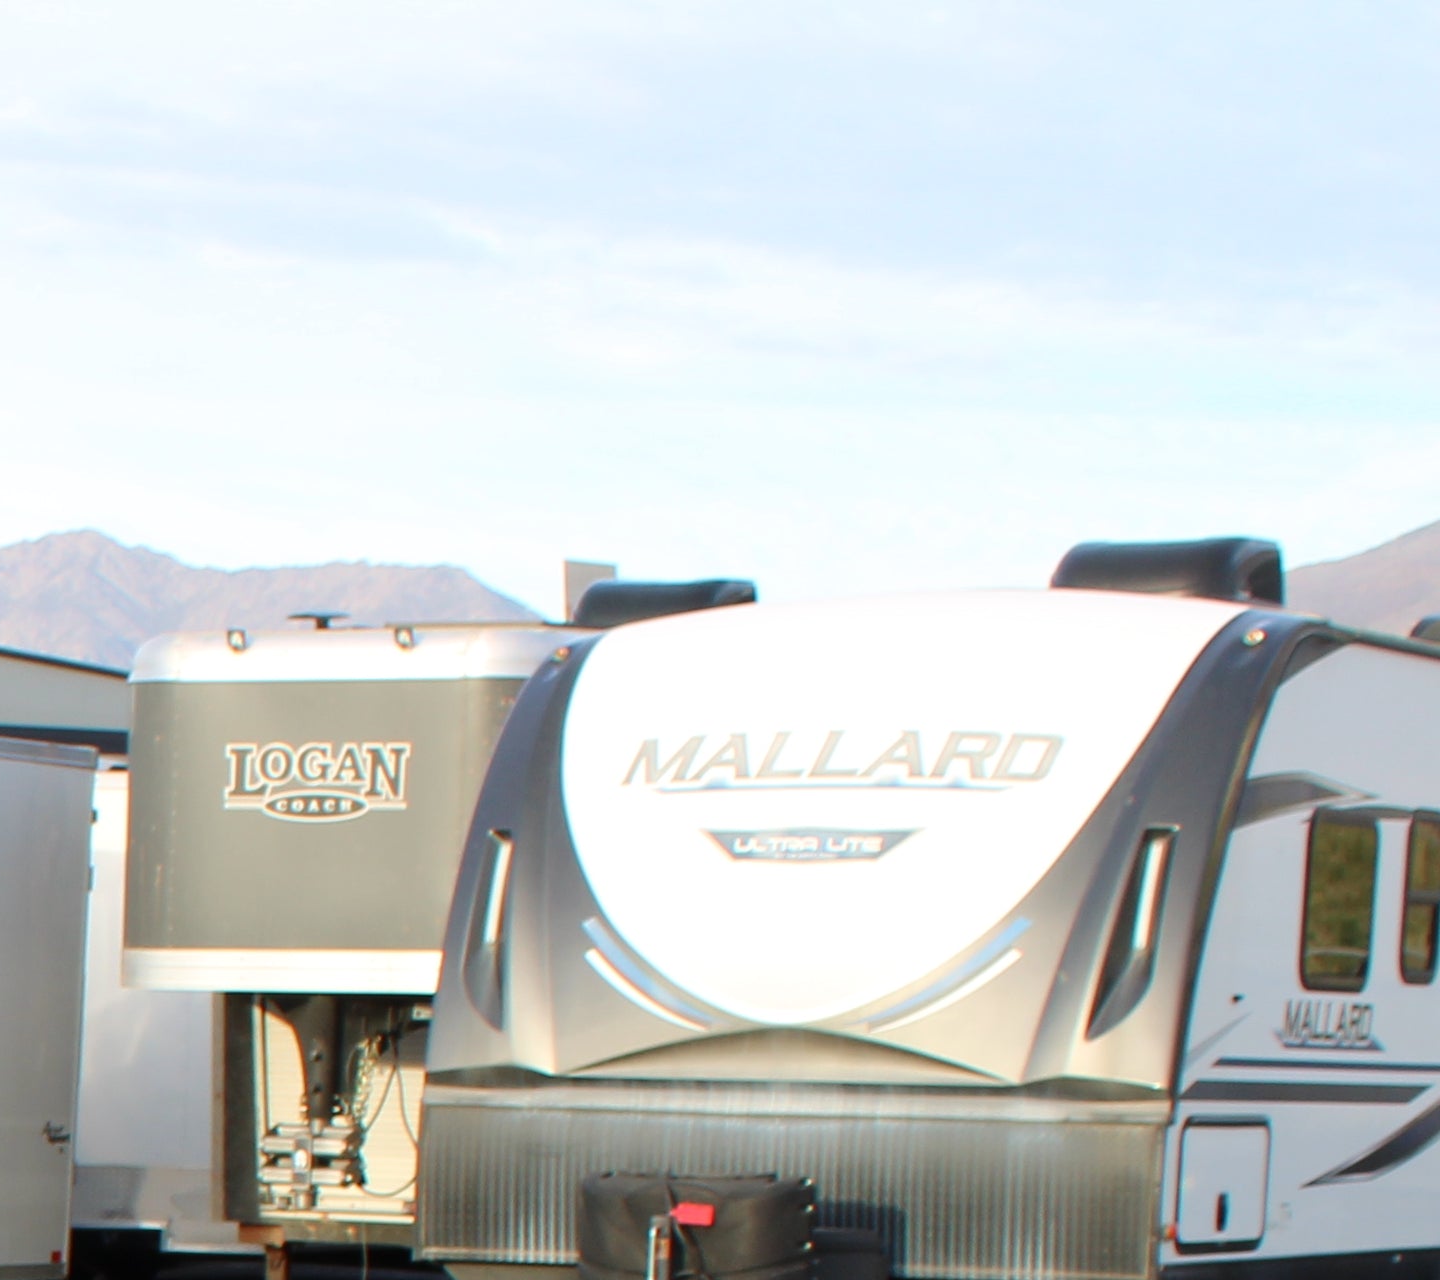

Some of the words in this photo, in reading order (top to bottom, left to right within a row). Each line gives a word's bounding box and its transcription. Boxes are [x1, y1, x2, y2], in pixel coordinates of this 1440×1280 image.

[226, 744, 411, 800] LOGAN
[621, 730, 1064, 786] MALLARD
[275, 797, 354, 813] COACH
[733, 835, 820, 853] ULTRA
[827, 836, 884, 853] LITE
[1284, 999, 1374, 1042] MALLARD
